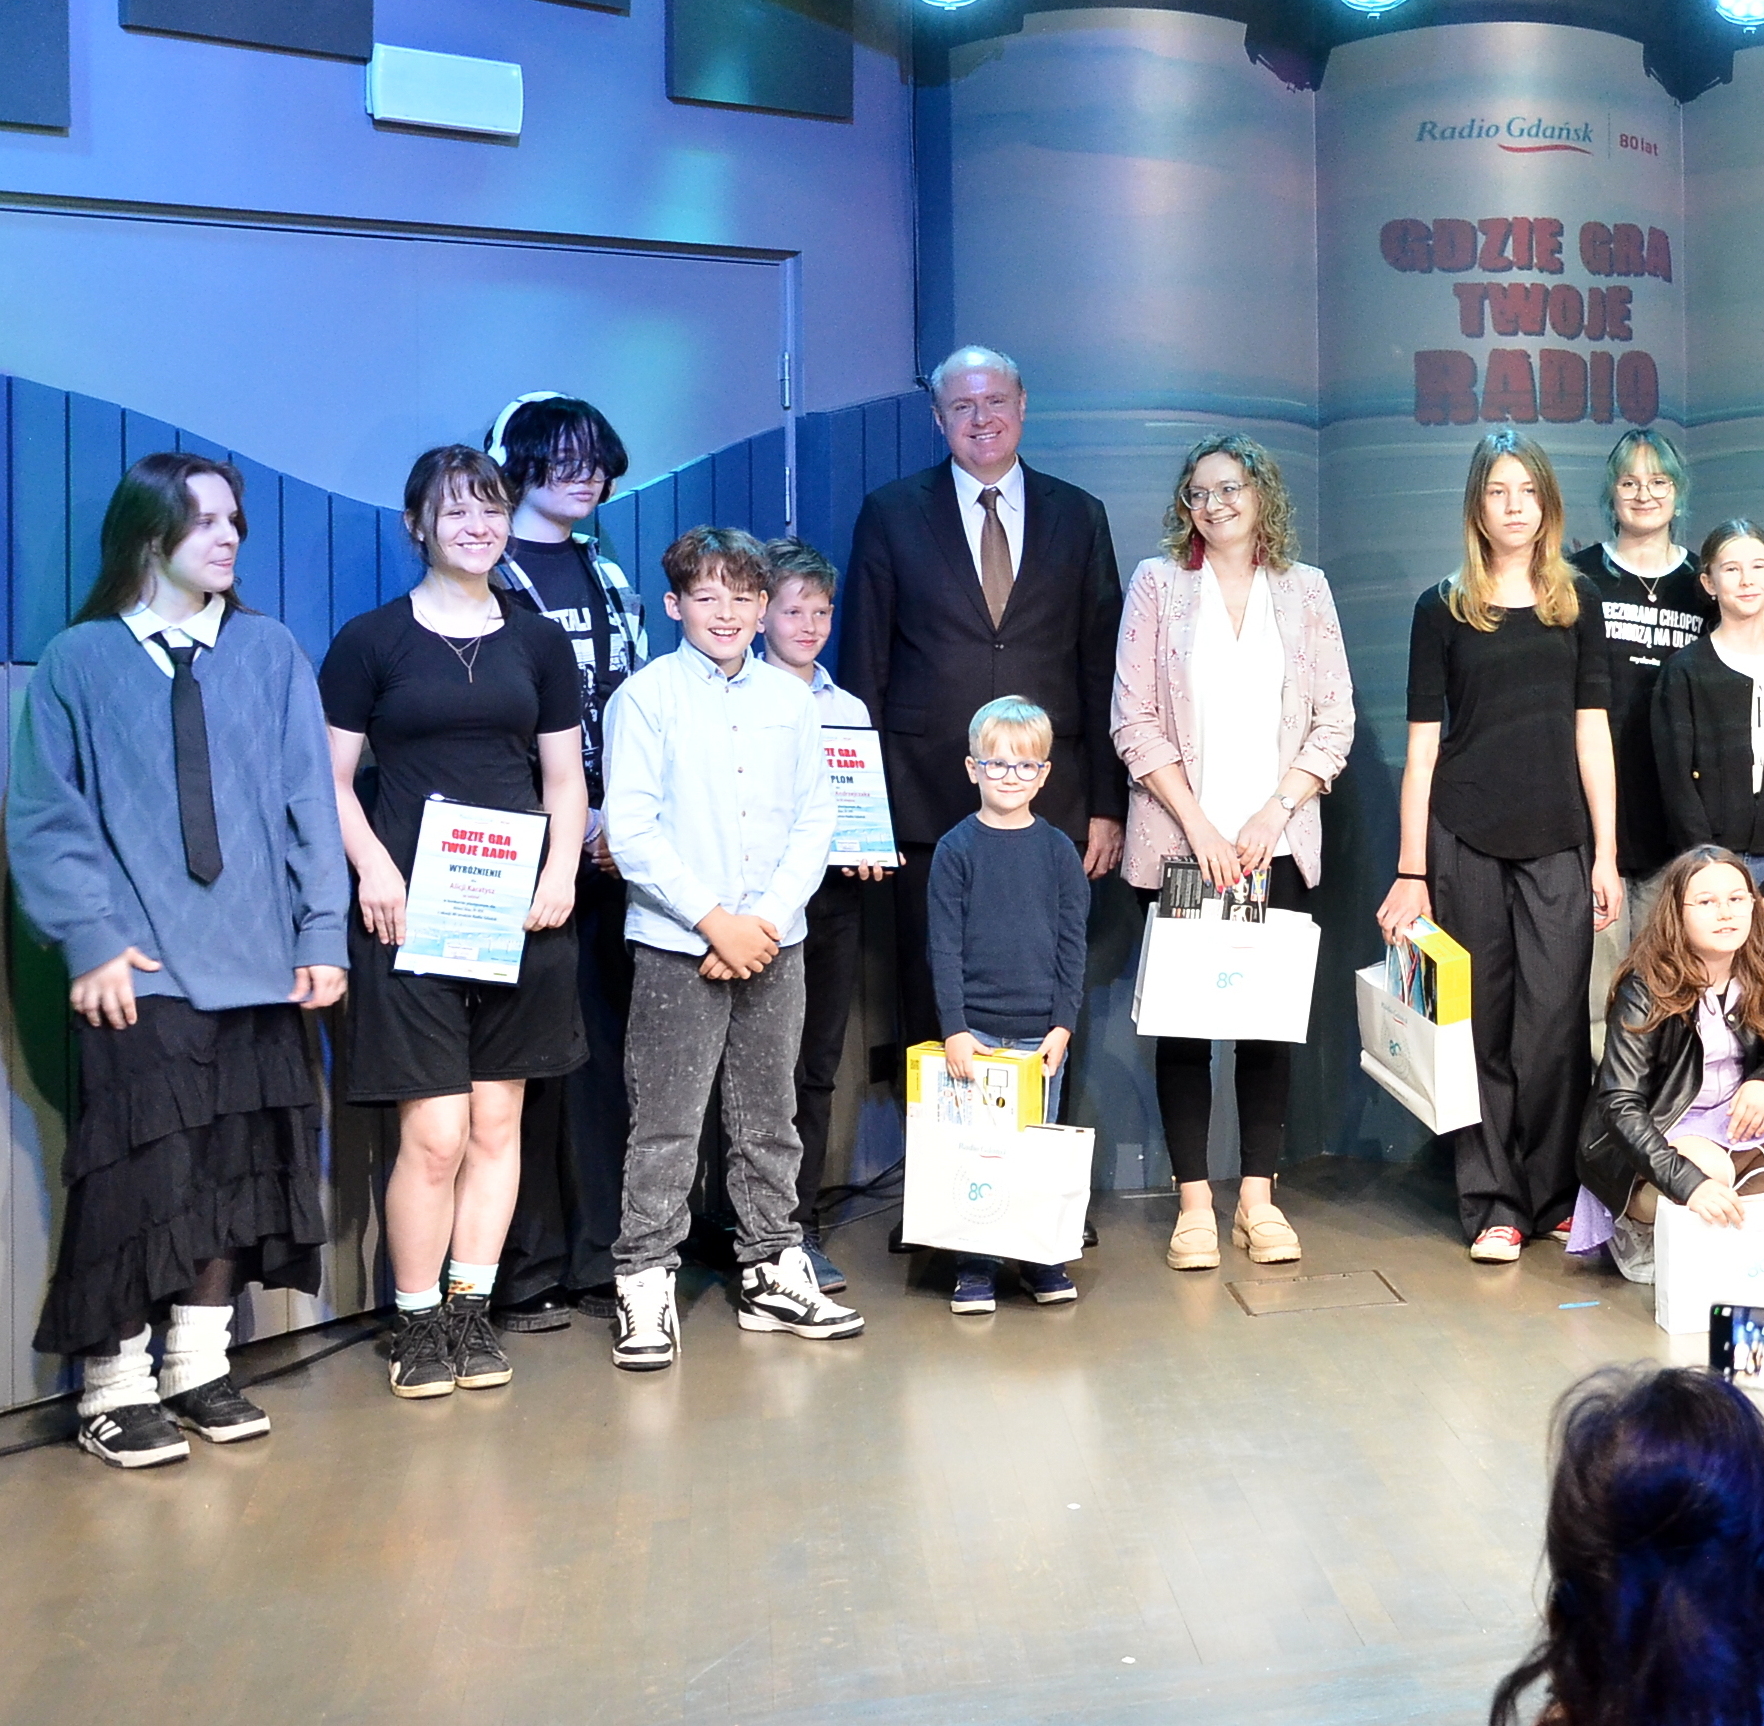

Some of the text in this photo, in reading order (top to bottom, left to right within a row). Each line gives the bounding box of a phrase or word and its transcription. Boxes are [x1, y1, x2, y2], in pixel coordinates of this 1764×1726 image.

[1415, 116, 1594, 143] Radio Gdańsk
[1619, 133, 1659, 157] 80 lat
[1379, 216, 1673, 284] GDZIE GRA
[1452, 282, 1633, 342] TWOJE
[1413, 347, 1660, 426] RADIO
[1604, 620, 1653, 649] YCHODZĄ
[1654, 627, 1670, 647] NA
[830, 775, 854, 784] PLOM
[441, 840, 518, 861] TWOJE RADIO
[451, 828, 512, 846] GDZIE GRA
